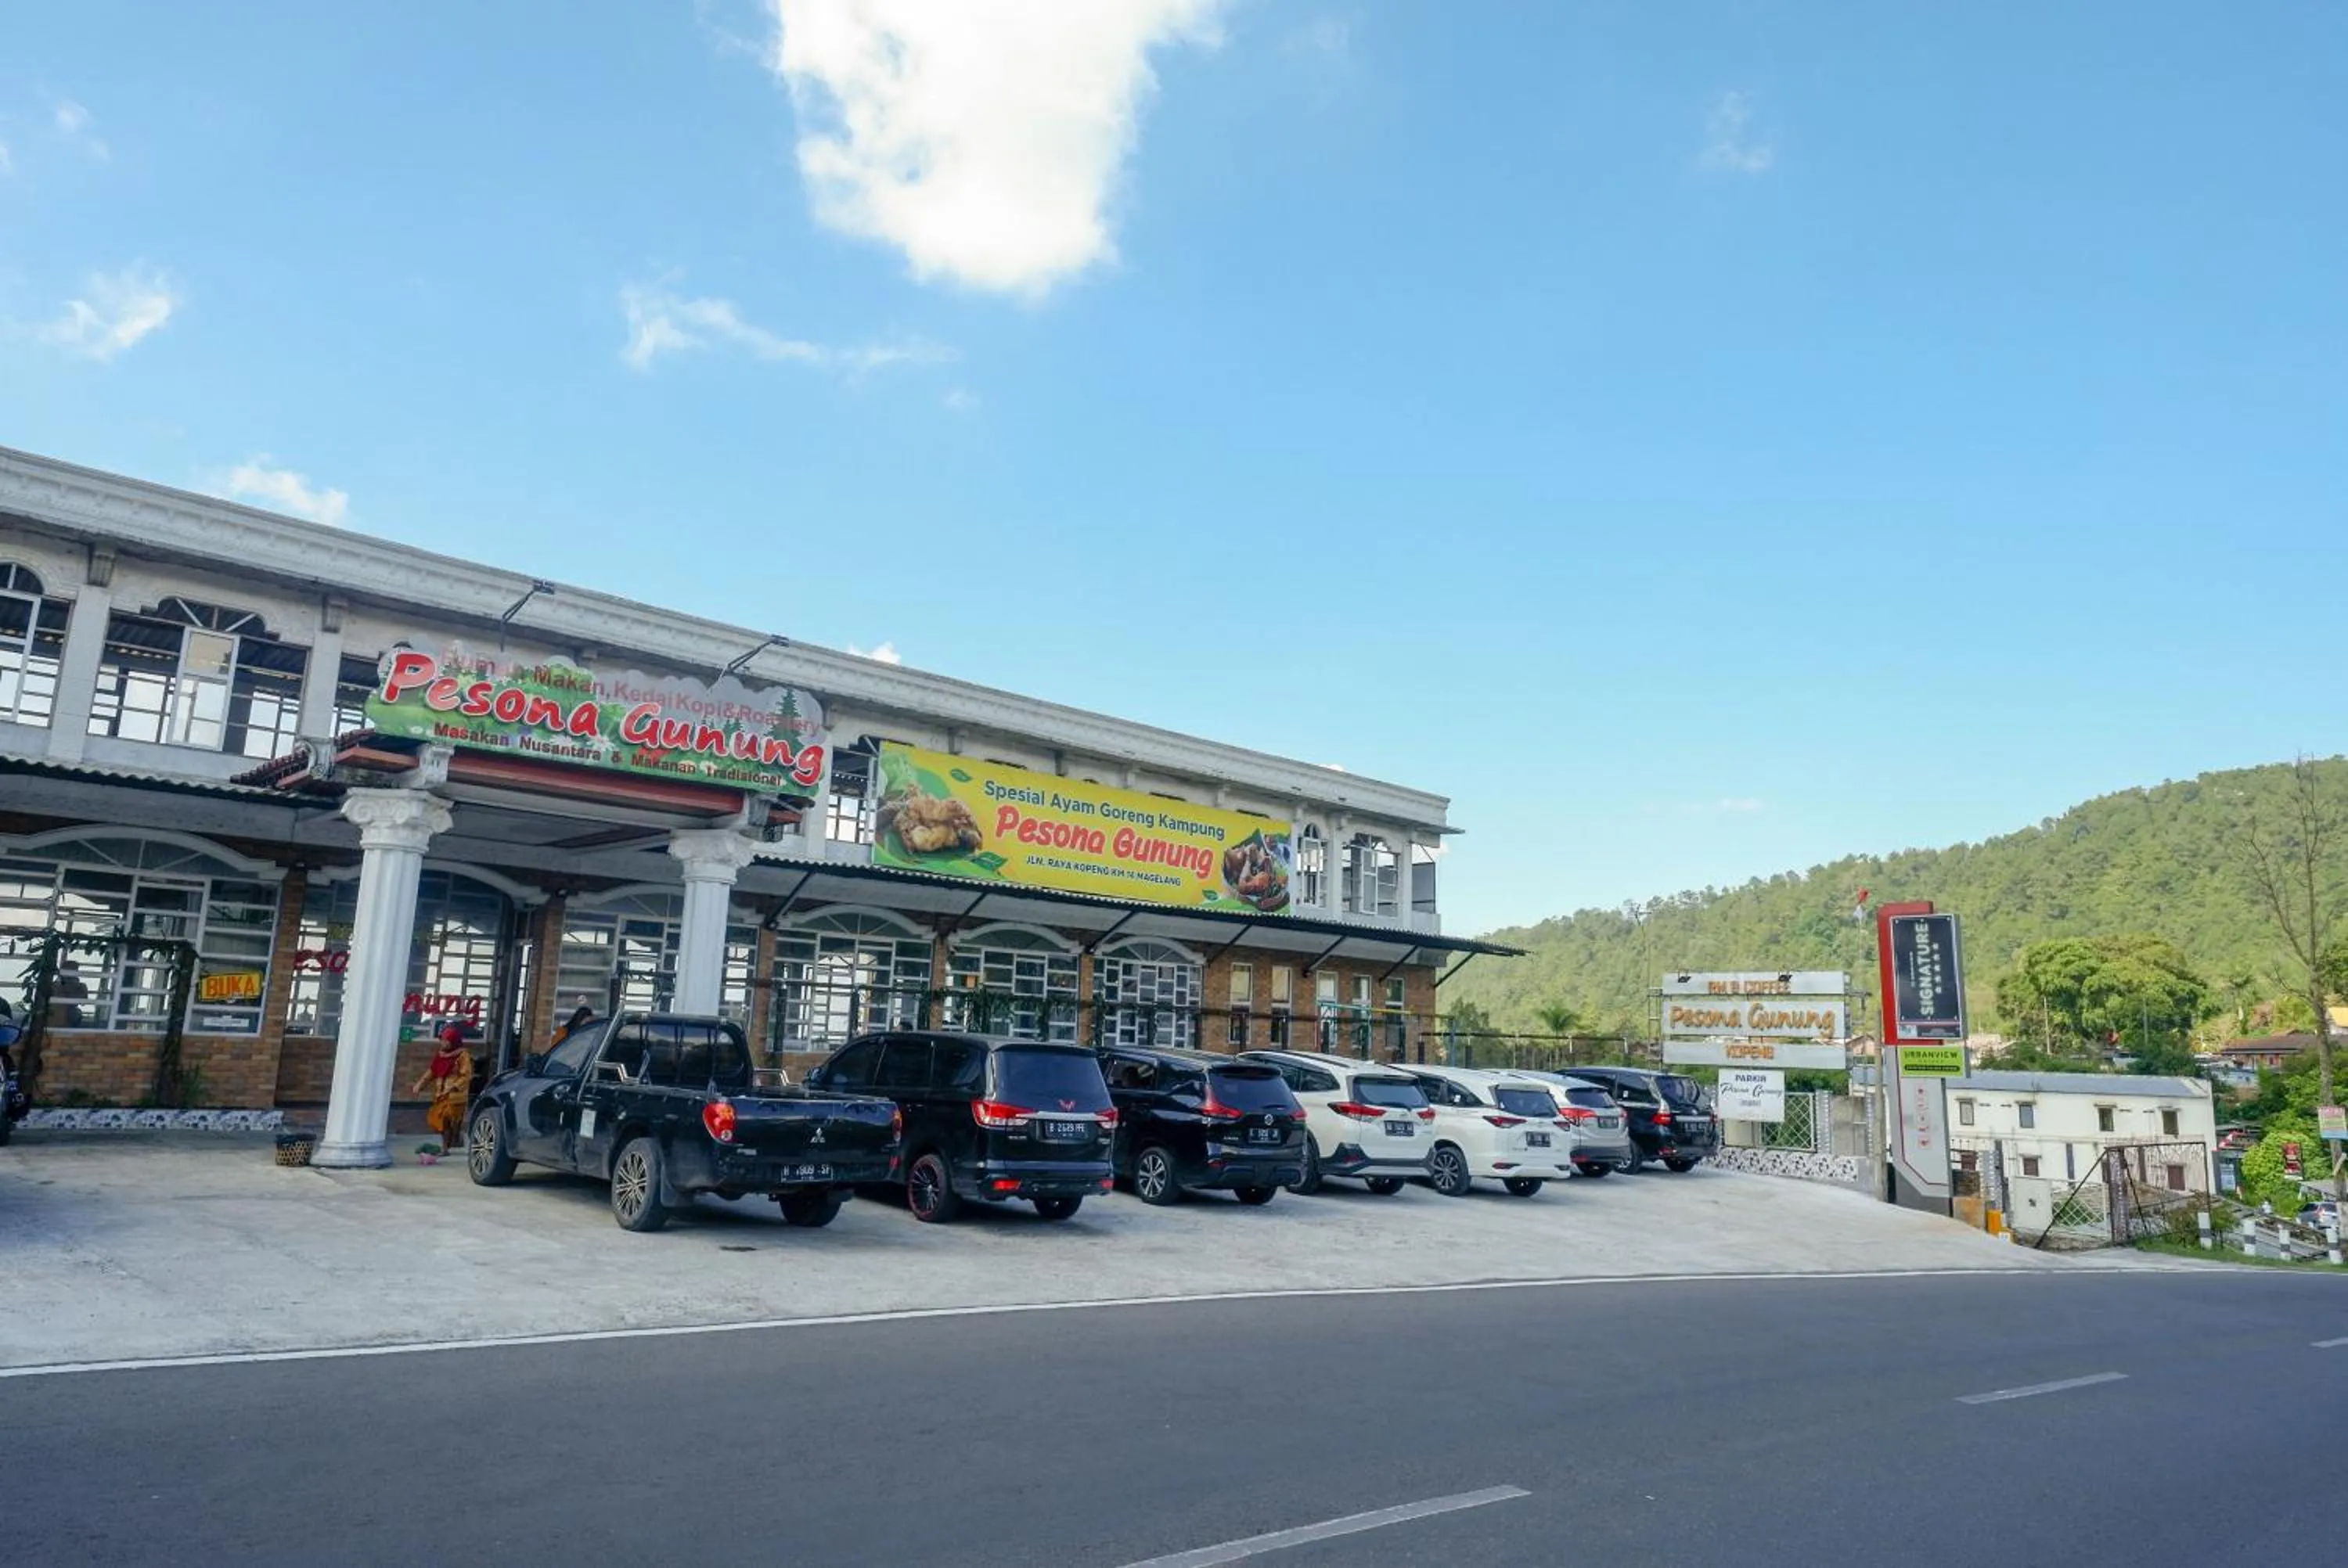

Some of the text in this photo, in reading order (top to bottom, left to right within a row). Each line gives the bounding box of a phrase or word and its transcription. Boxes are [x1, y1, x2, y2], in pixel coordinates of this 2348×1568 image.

[614, 680, 672, 707] Kedai
[380, 651, 824, 786] Pesona Gunung
[434, 721, 509, 746] Masakan
[519, 735, 601, 761] Nusantara
[611, 751, 623, 763] &
[632, 753, 696, 774] Makanan
[985, 780, 1225, 841] Spesial Ayam Goreng Kampung
[996, 804, 1214, 879] Pesona Gunung
[1048, 858, 1071, 869] RAYA
[1074, 863, 1109, 875] KOPENG
[1136, 870, 1181, 886] MAGELANG
[206, 976, 254, 997] BUKA
[1743, 980, 1791, 994] COFFEE
[1914, 922, 1936, 1016] SIGNATURE
[402, 992, 483, 1027] nung
[1670, 1002, 1836, 1040] Pesona Gunung
